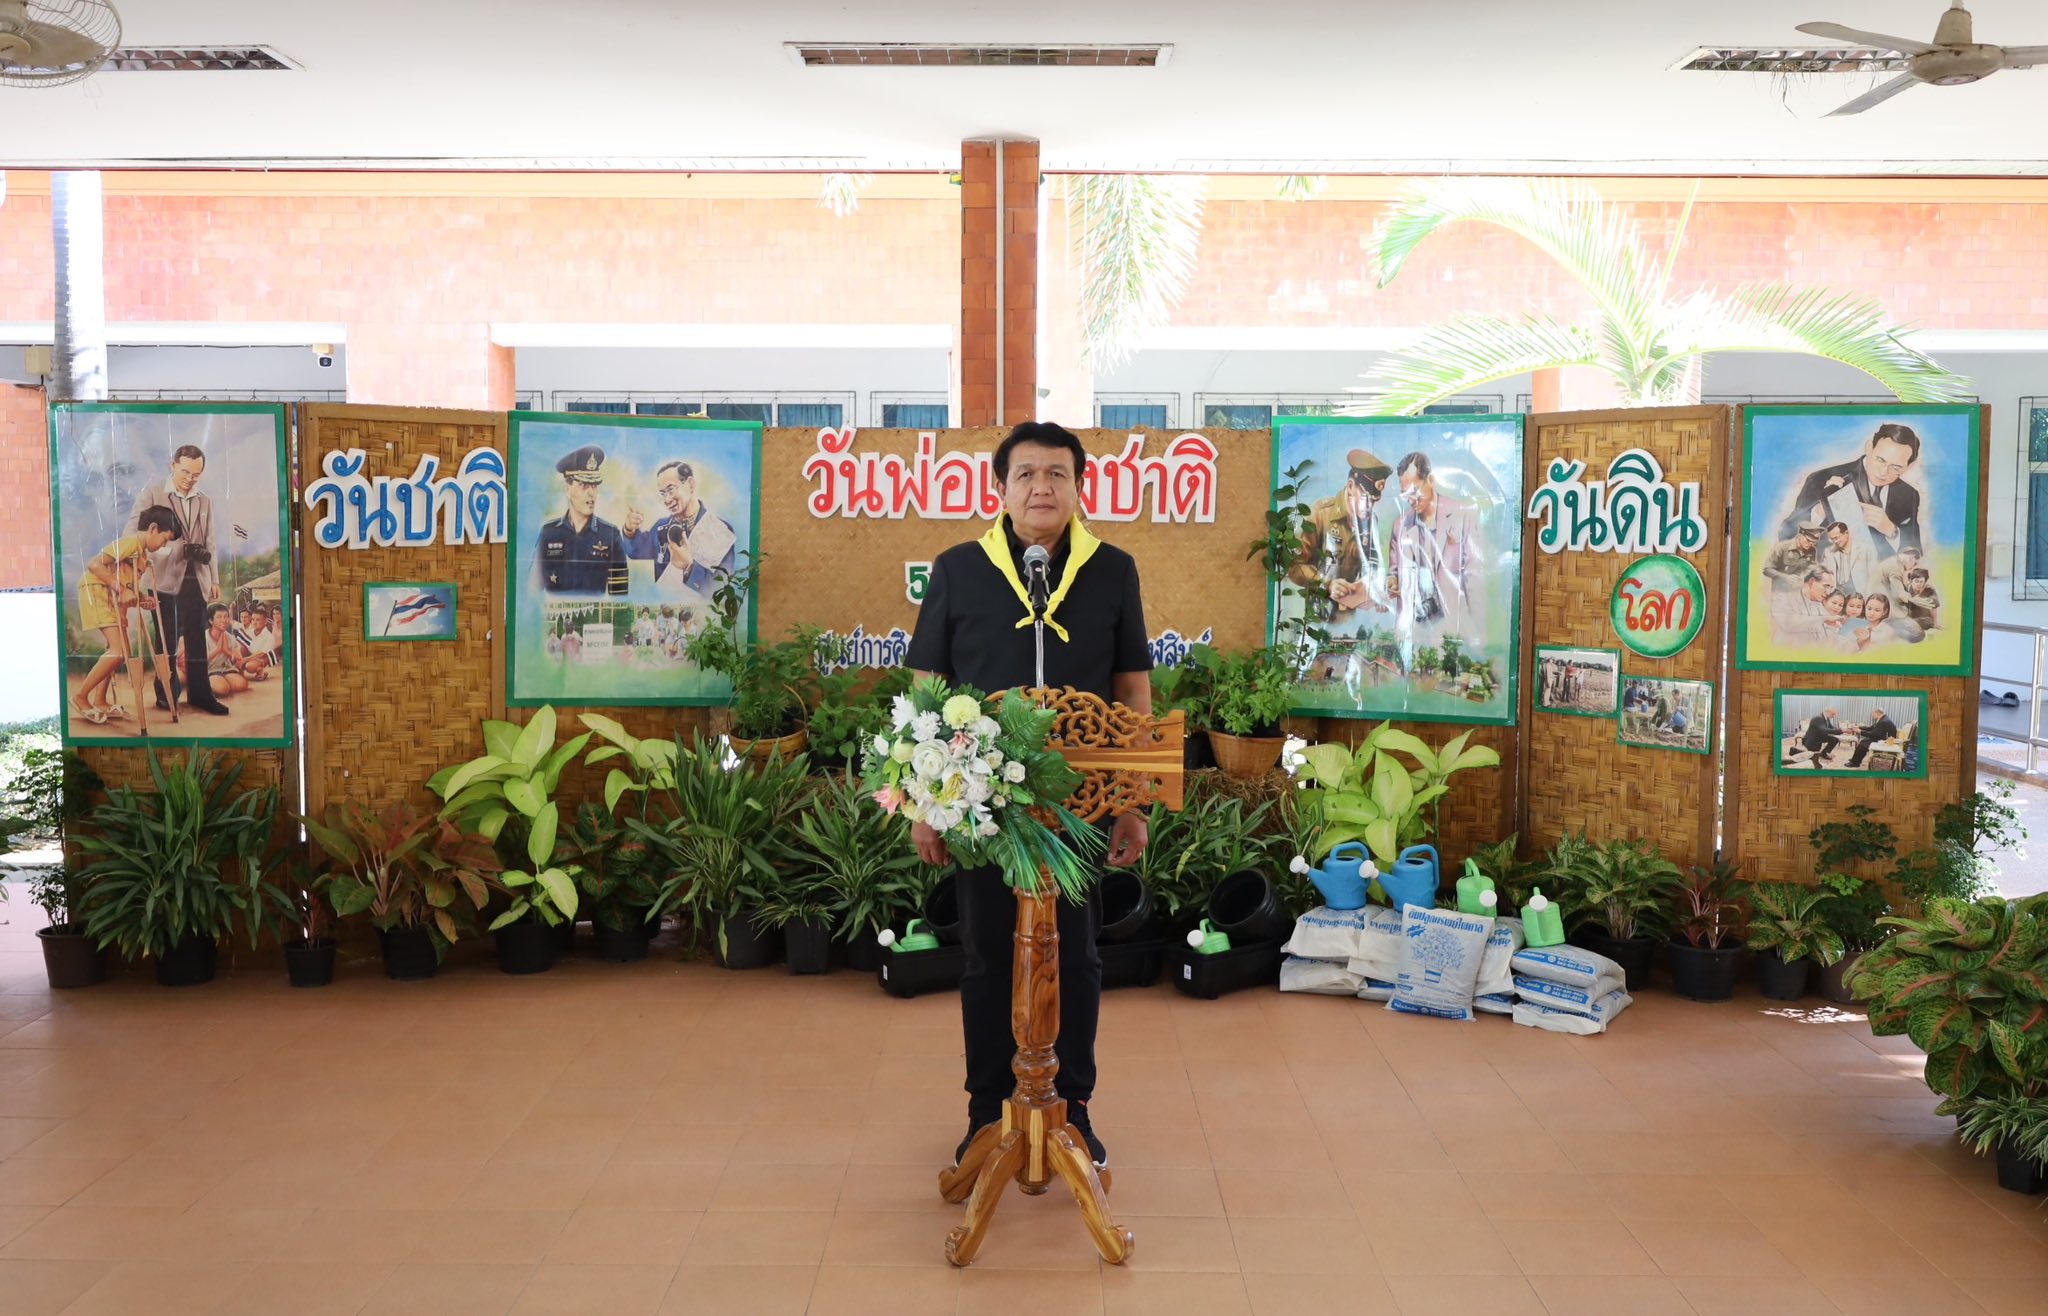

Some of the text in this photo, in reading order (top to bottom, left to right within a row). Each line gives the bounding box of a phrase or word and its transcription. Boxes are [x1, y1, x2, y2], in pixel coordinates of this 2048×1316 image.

[311, 450, 506, 544] วันชาติ
[1530, 452, 1701, 549] วันดิน
[908, 564, 930, 601] 5
[1617, 576, 1693, 633] โลก
